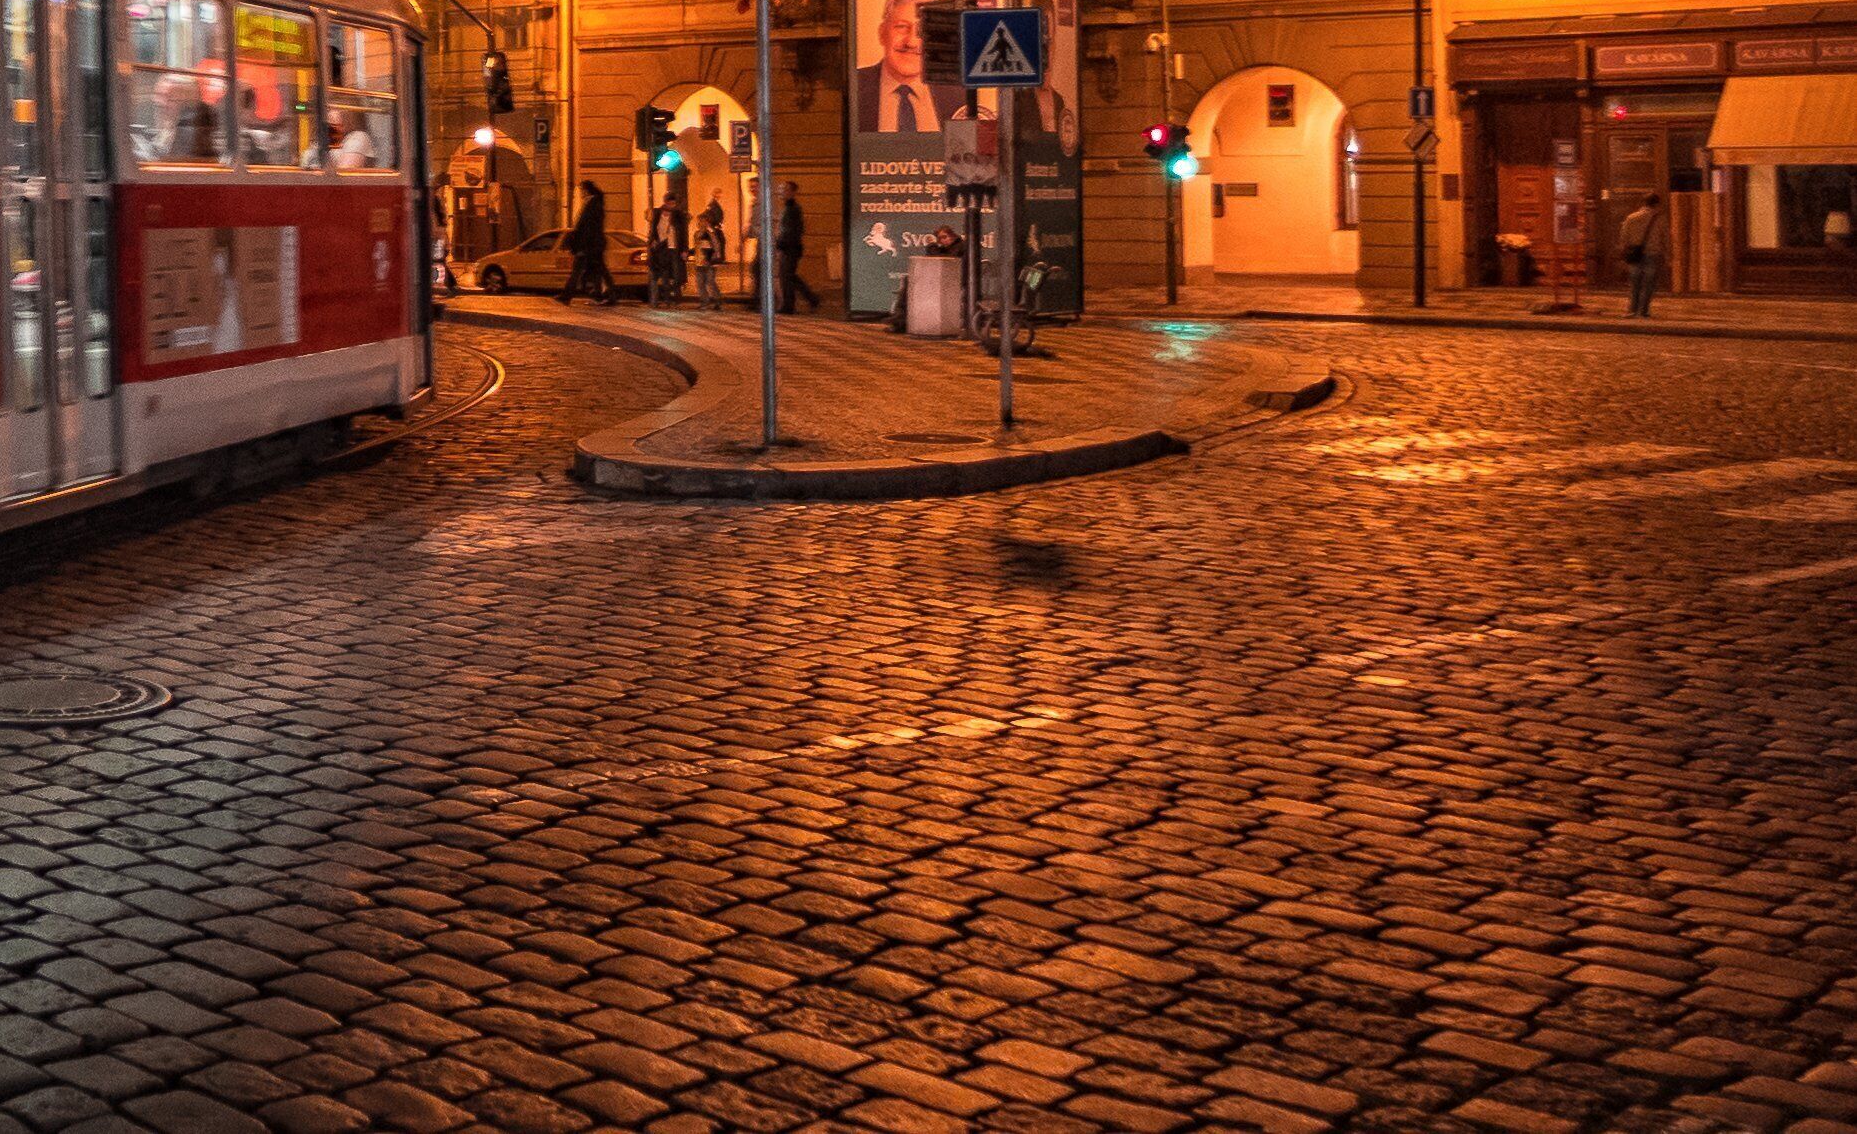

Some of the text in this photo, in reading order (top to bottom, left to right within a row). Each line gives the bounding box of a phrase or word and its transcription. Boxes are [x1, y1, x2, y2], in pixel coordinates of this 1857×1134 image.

[860, 159, 946, 176] LIDOVÉ VE
[860, 182, 923, 194] zastavte
[860, 198, 944, 214] rozhodnutí
